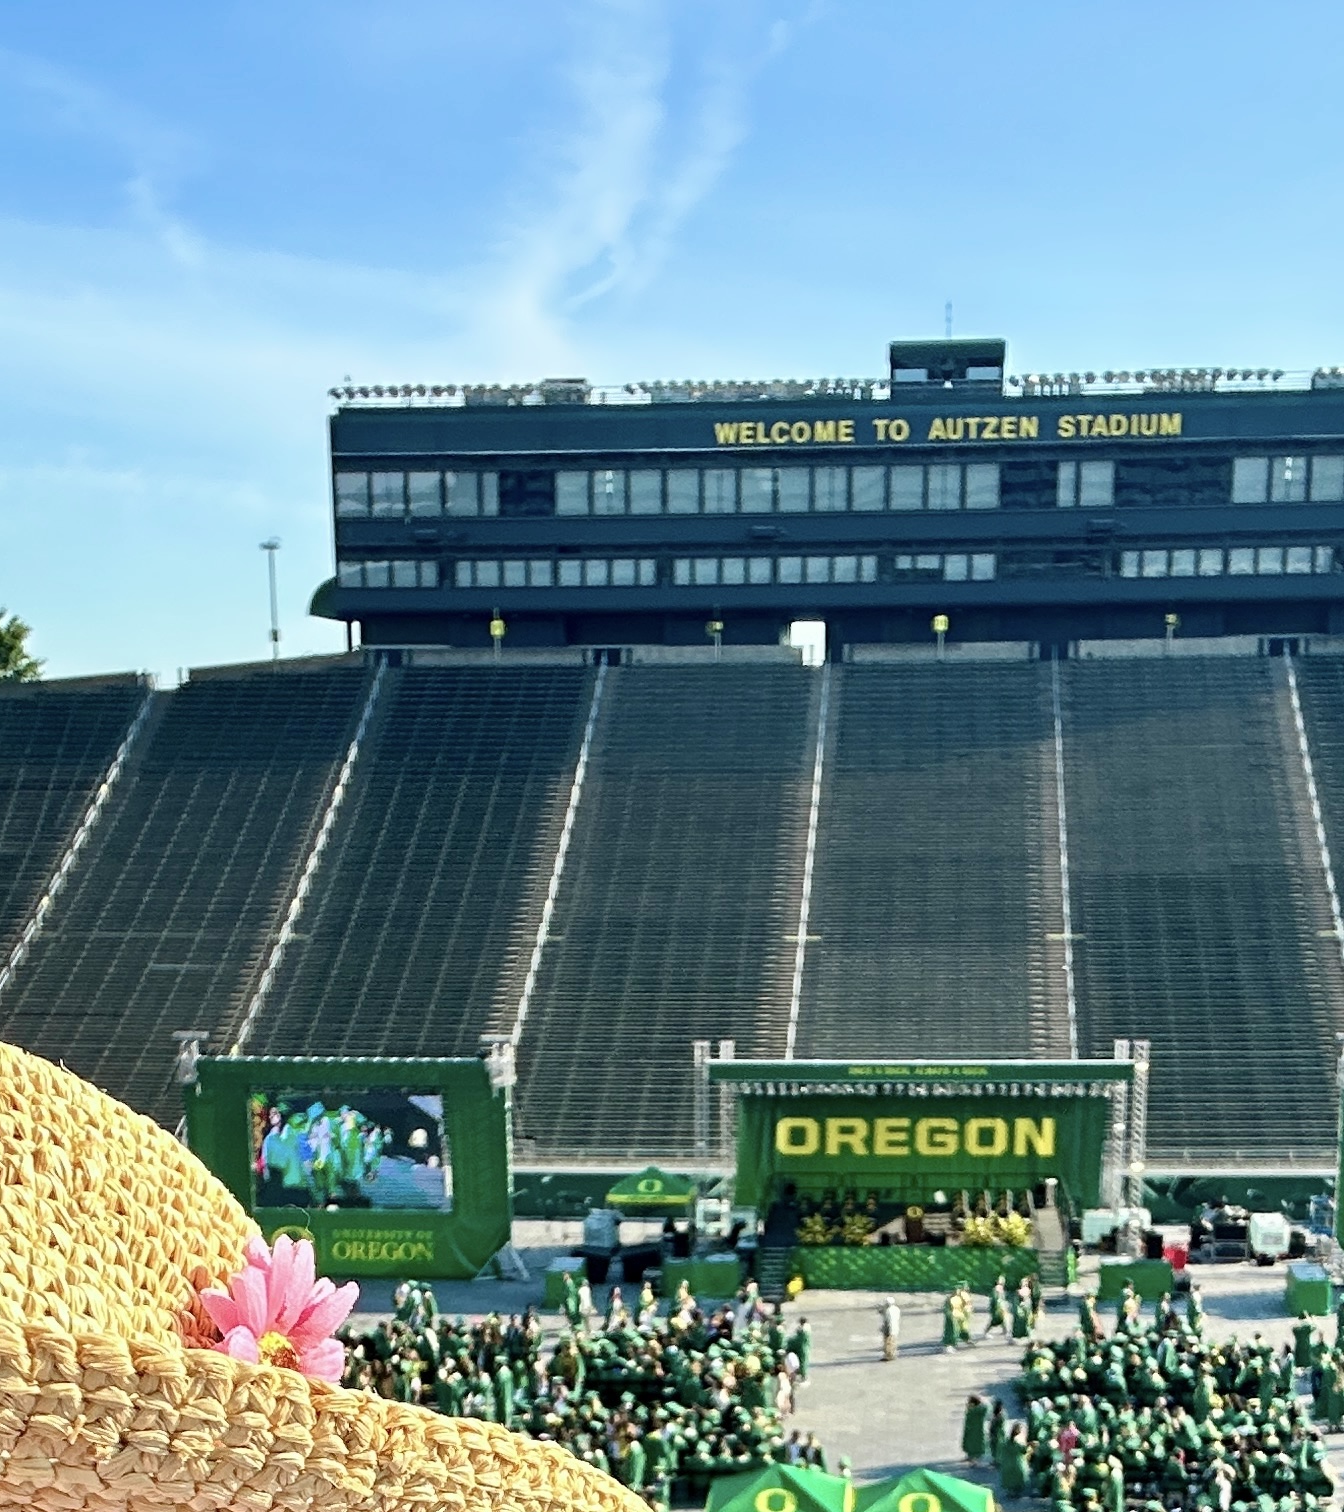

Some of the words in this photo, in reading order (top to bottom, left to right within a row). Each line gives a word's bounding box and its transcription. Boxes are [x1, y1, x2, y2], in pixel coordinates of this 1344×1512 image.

[714, 419, 854, 444] WELCOME
[873, 418, 910, 441] TO
[928, 416, 1040, 440] AUTZEN
[1058, 413, 1182, 438] STADIUM
[774, 1115, 1057, 1158] OREGON
[331, 1240, 434, 1261] OREGON
